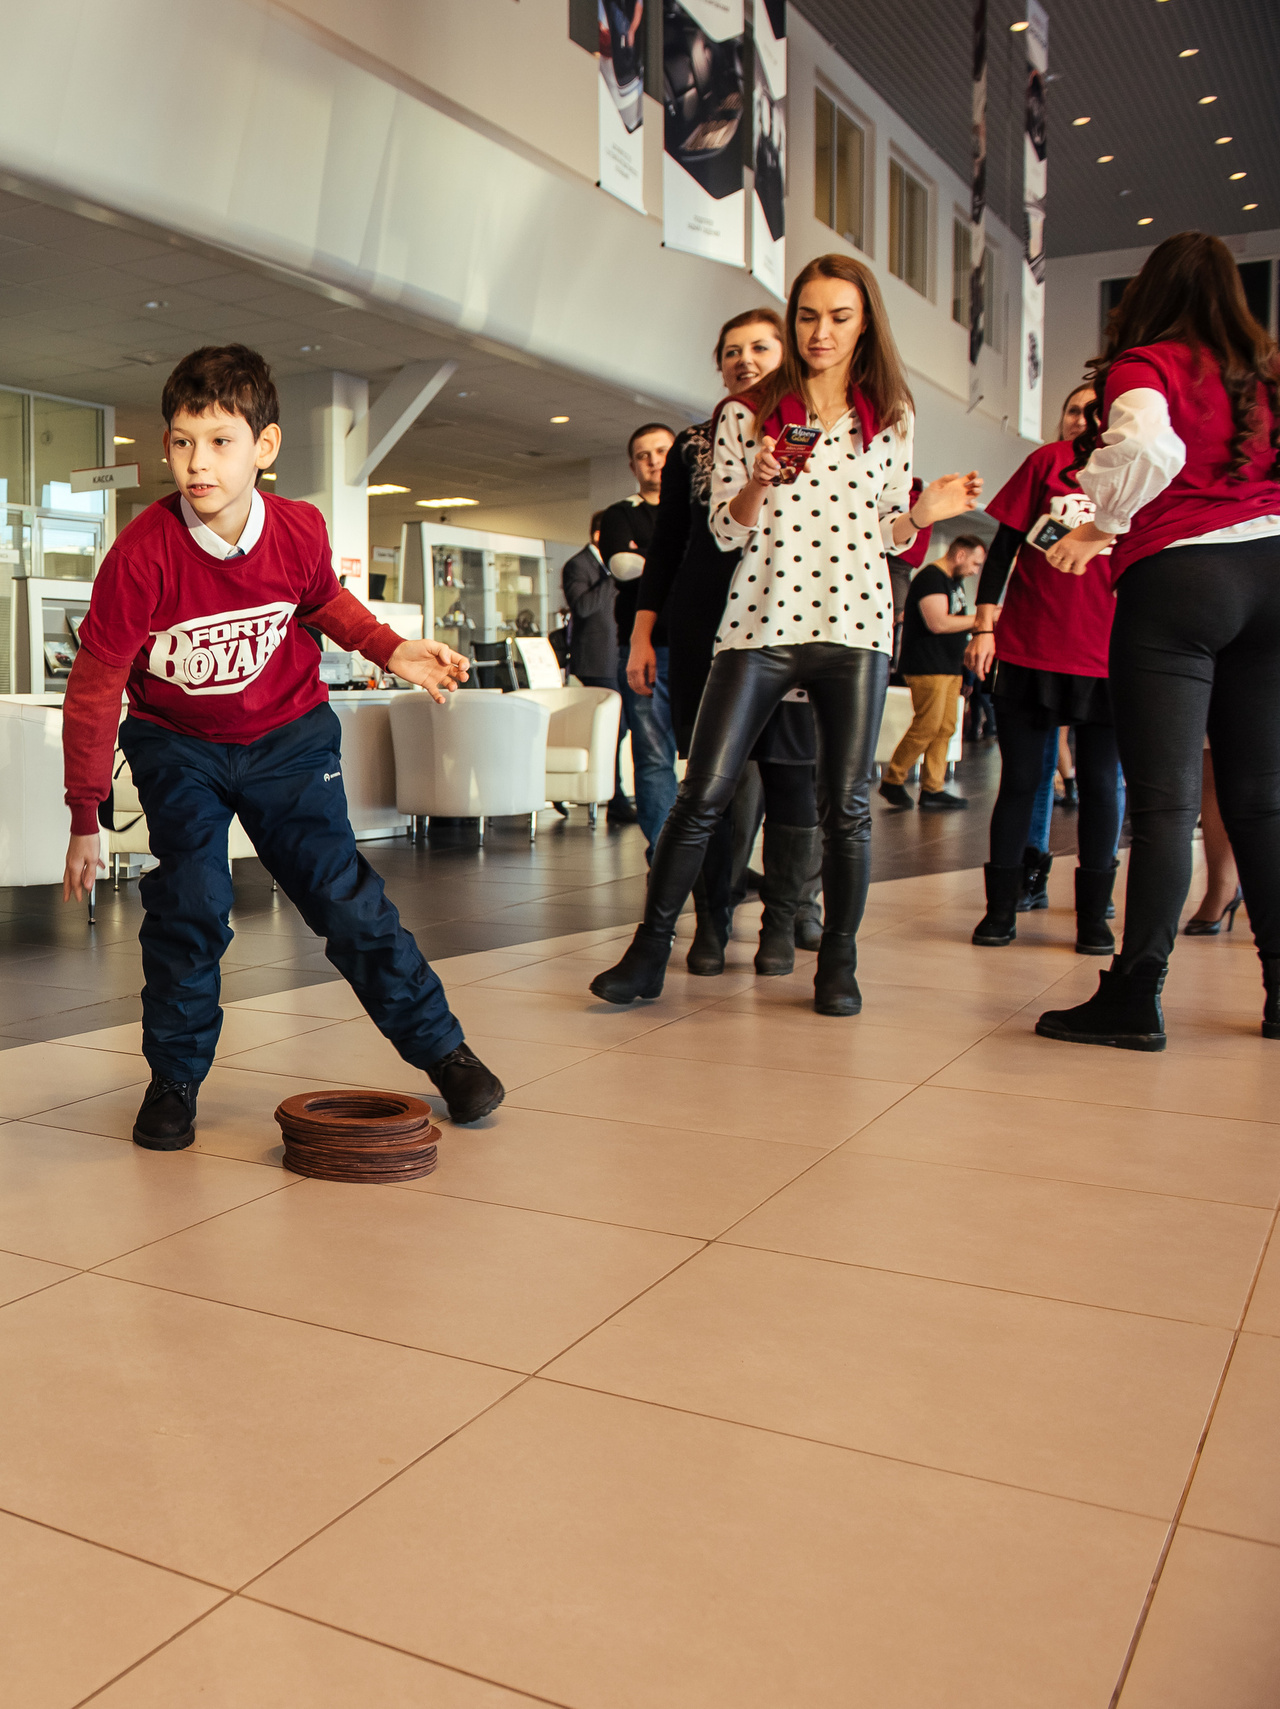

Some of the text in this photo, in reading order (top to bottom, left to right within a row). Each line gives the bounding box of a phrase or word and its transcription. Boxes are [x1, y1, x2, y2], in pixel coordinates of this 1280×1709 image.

[792, 428, 816, 438] Alpen
[93, 474, 114, 484] КАССА
[192, 616, 270, 648] FORT
